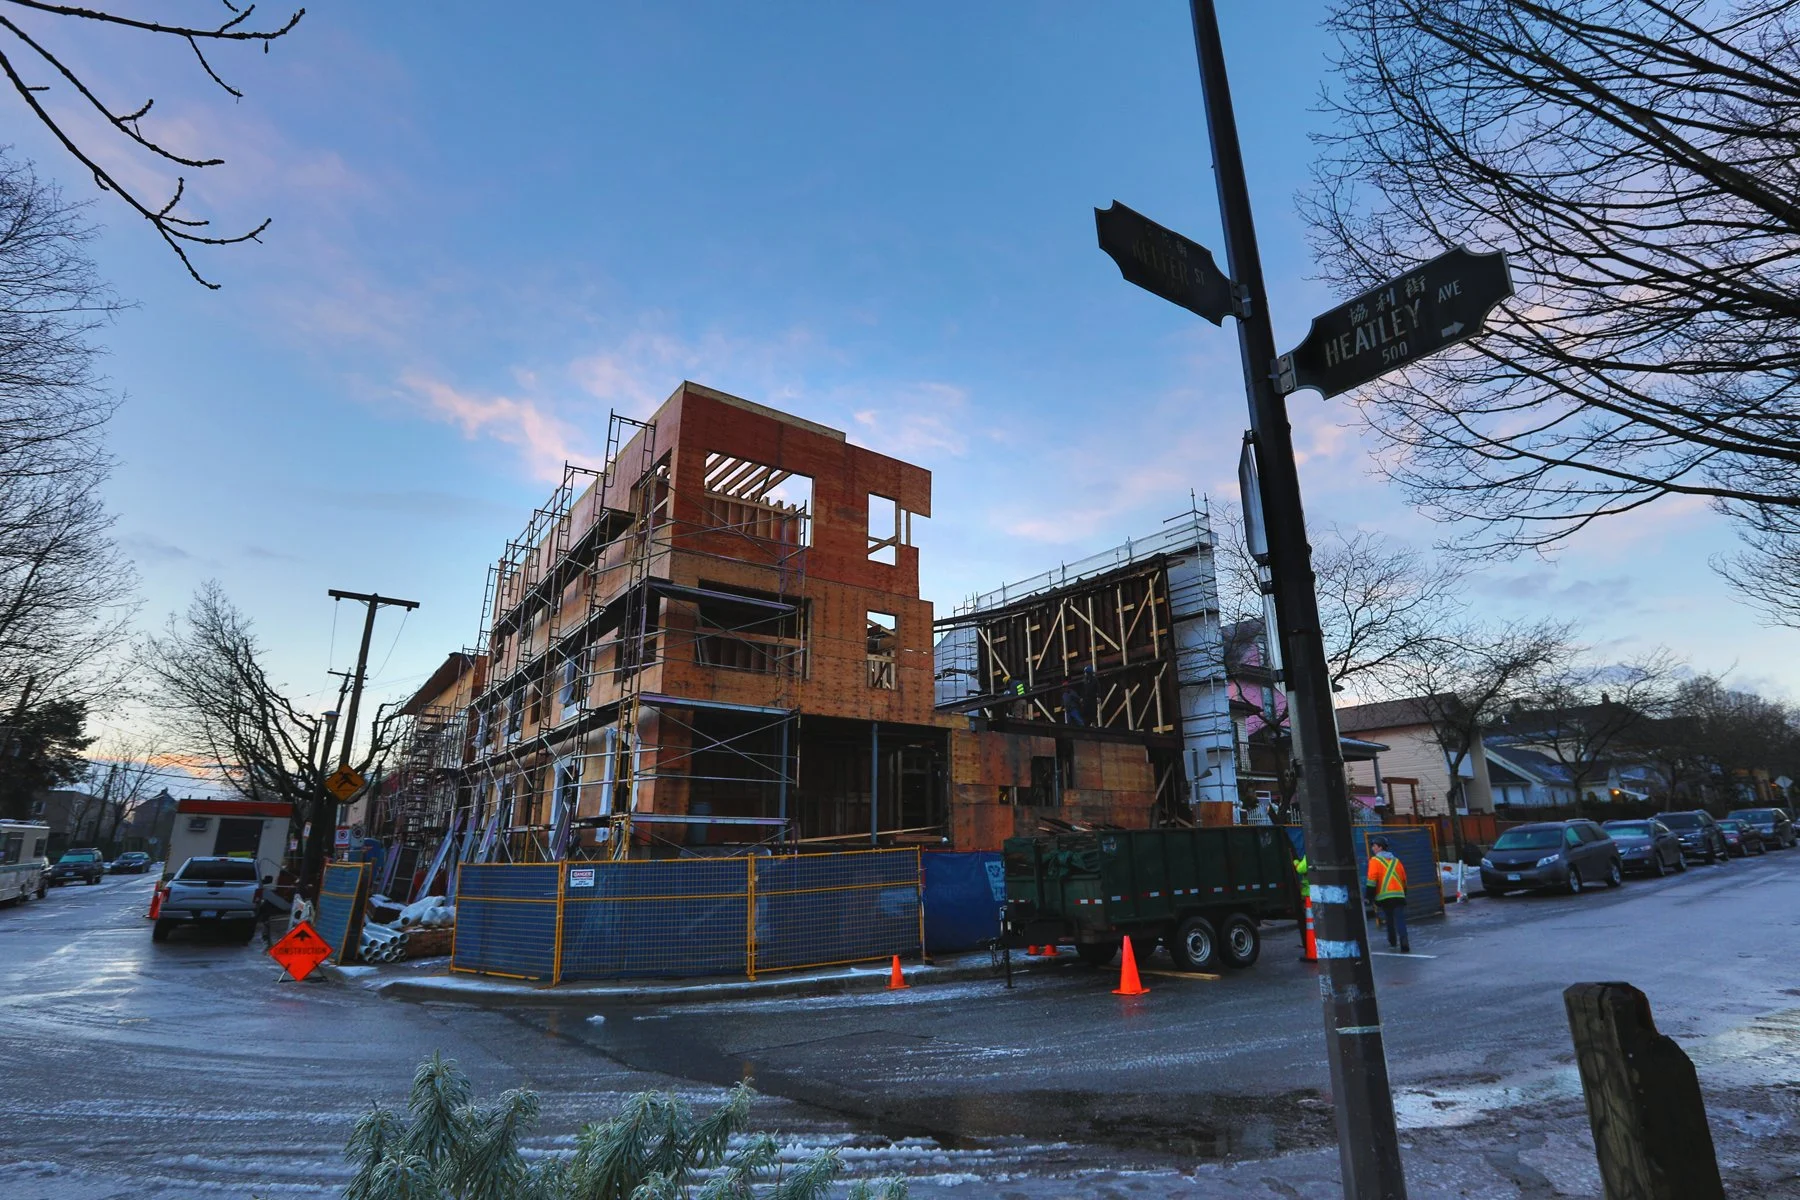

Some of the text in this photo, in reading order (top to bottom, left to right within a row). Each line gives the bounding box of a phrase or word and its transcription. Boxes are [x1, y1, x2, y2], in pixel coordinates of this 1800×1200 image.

[1193, 266, 1205, 287] ST
[1325, 279, 1463, 368] HEATLEY AVE
[1381, 341, 1408, 365] 500
[274, 946, 327, 955] CONSTRUCTION
